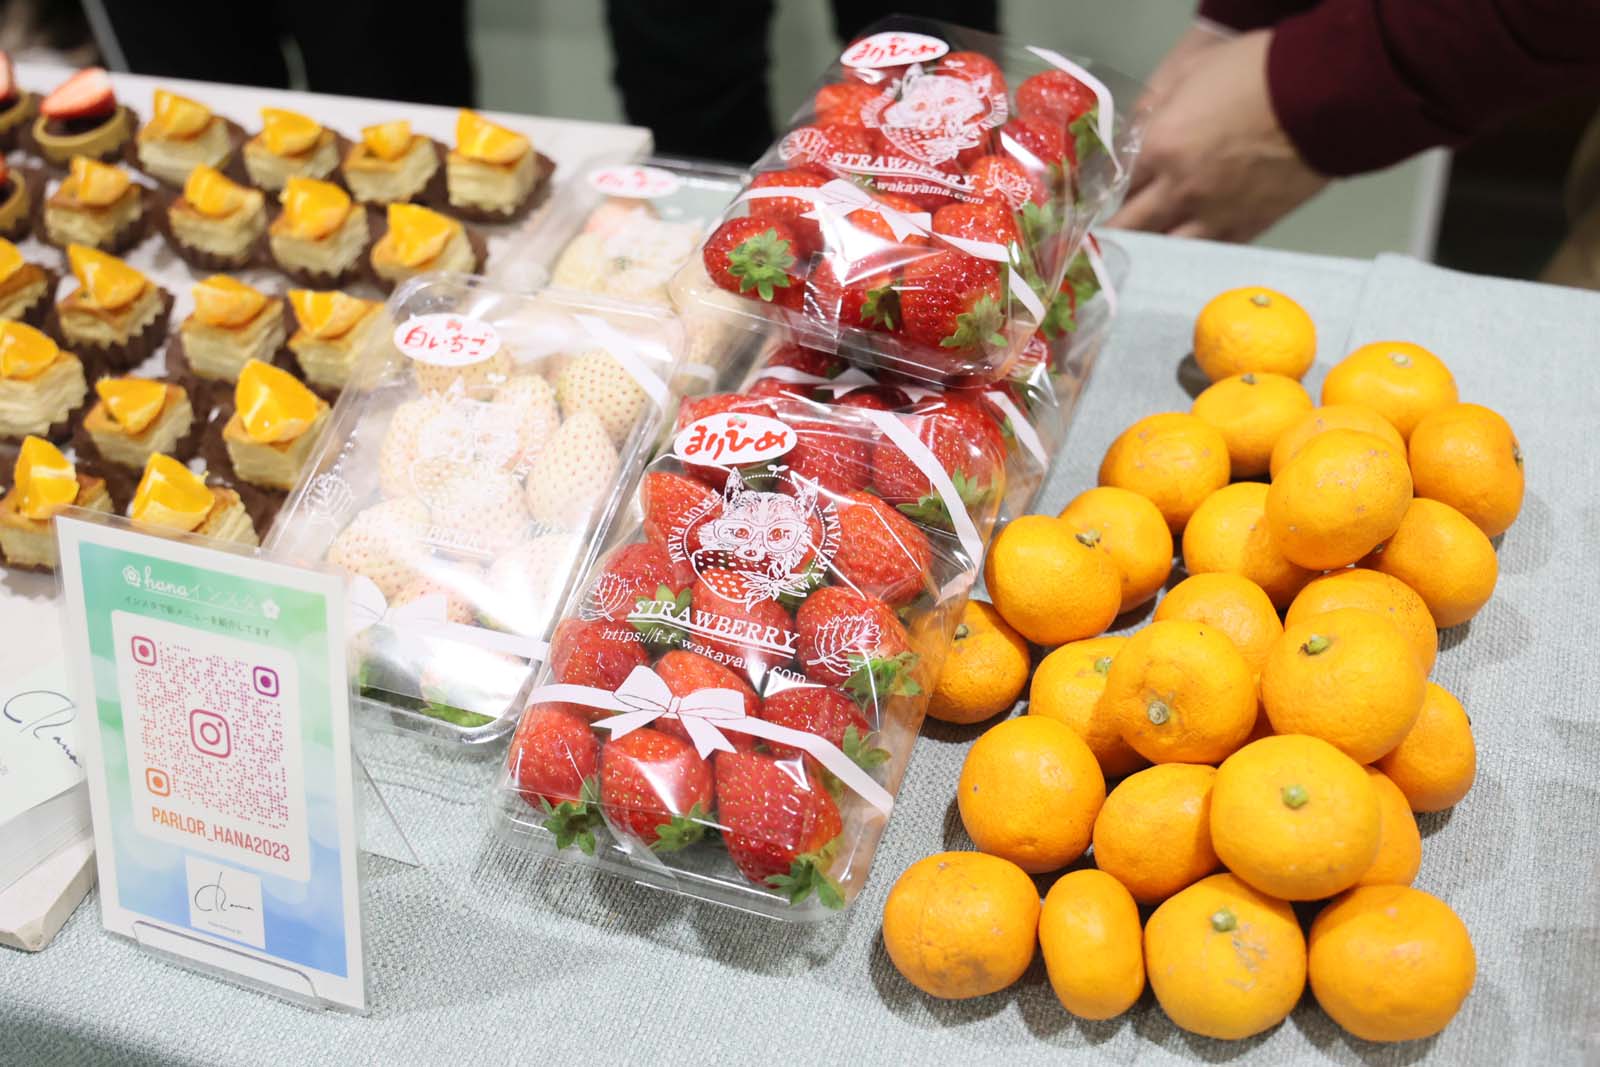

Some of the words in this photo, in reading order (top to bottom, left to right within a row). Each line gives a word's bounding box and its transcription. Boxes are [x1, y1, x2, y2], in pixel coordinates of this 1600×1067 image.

[829, 152, 979, 190] STRAWBERRY
[403, 325, 494, 356] 白いちご
[685, 425, 787, 460] まりひめ
[679, 488, 722, 525] FRUIT
[667, 525, 689, 563] FARM
[630, 600, 800, 651] STRAWBERRY
[601, 627, 807, 684] https://f-f-wakaya.com
[152, 806, 290, 862] PARLOR_HANA2023
